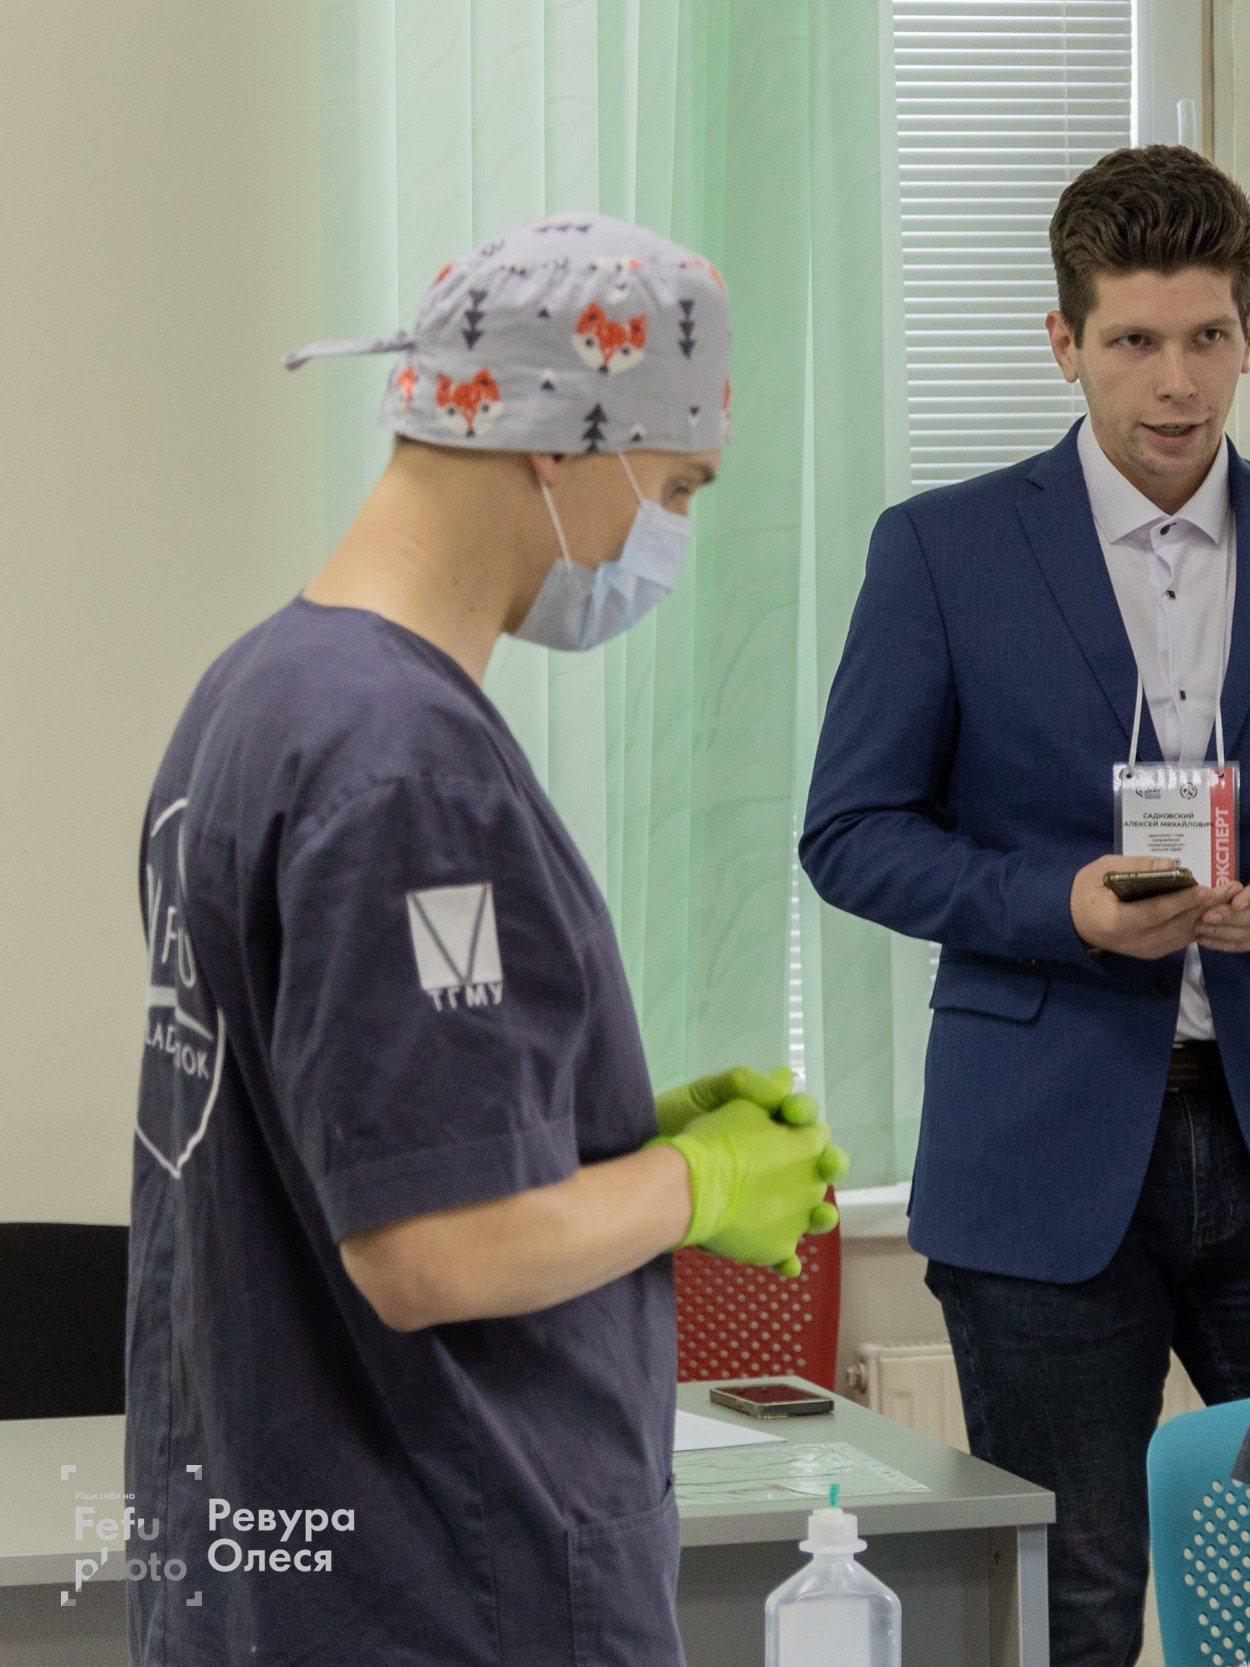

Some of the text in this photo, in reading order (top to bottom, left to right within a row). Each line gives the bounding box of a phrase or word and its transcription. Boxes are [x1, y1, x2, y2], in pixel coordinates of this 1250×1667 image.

[1142, 811, 1194, 819] САДКОВСКИЙ
[1124, 820, 1213, 828] АЛЕКСЕЙ МИХАЙЛОВИЧ
[1215, 807, 1230, 888] ЭКСПЕРТ
